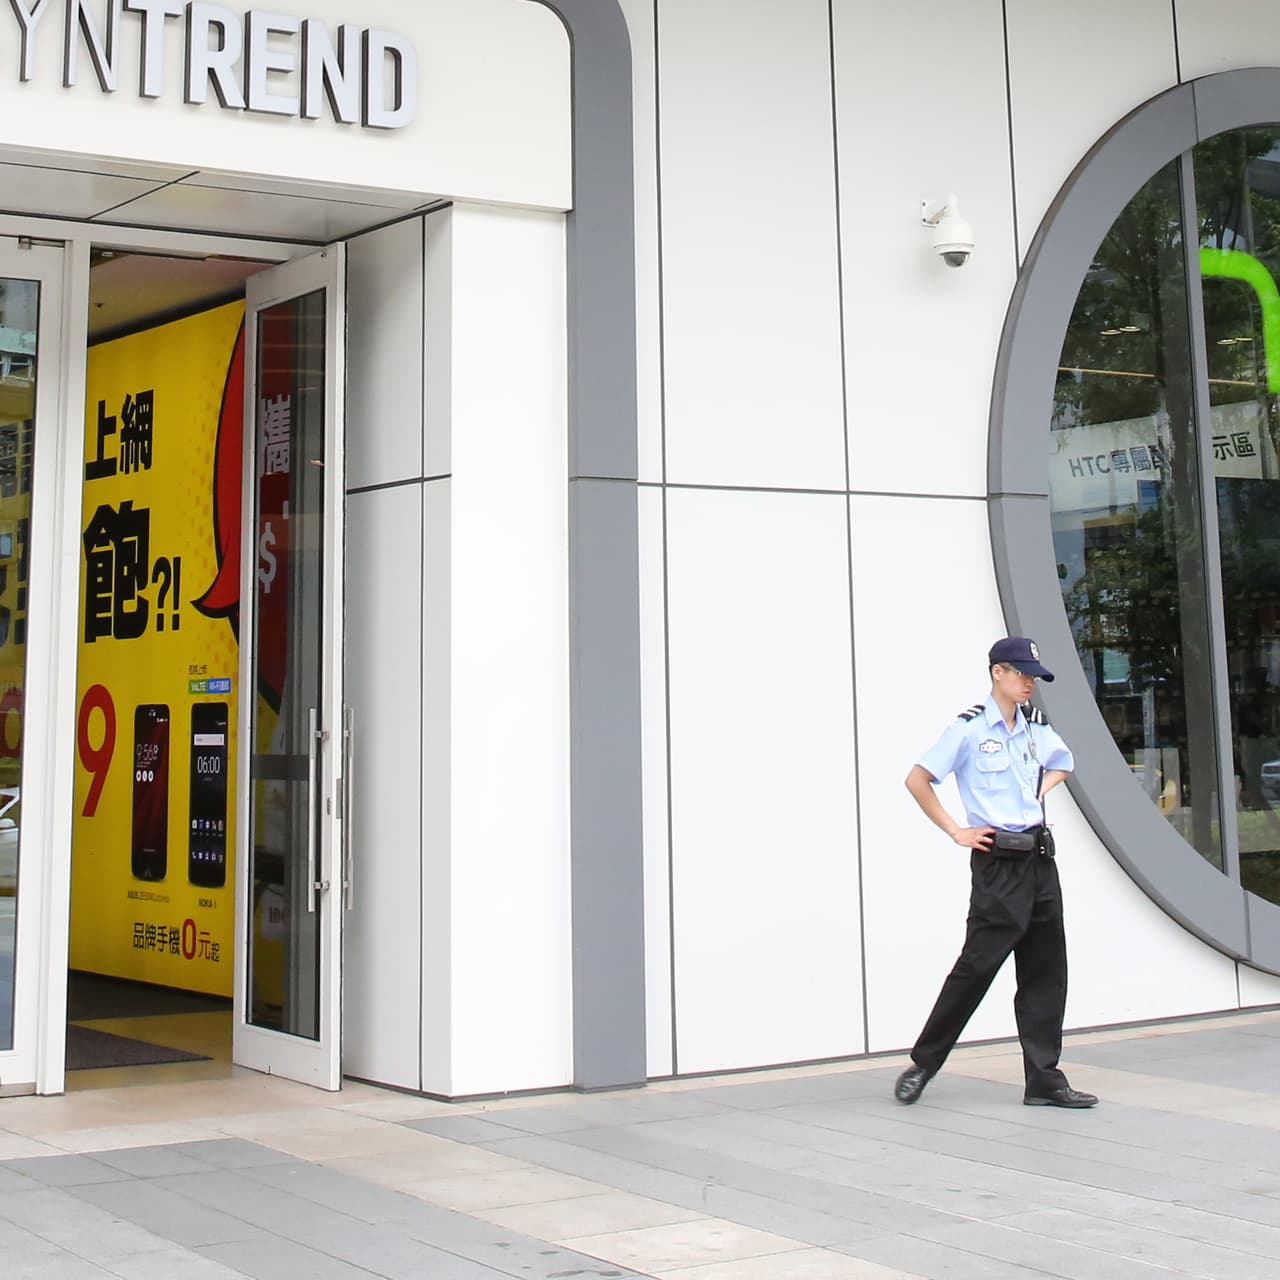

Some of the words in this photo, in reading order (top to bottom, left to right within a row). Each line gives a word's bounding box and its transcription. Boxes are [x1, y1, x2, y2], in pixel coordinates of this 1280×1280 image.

[86, 389, 154, 481] 上網
[77, 684, 116, 817] 9
[197, 756, 220, 773] 06:00
